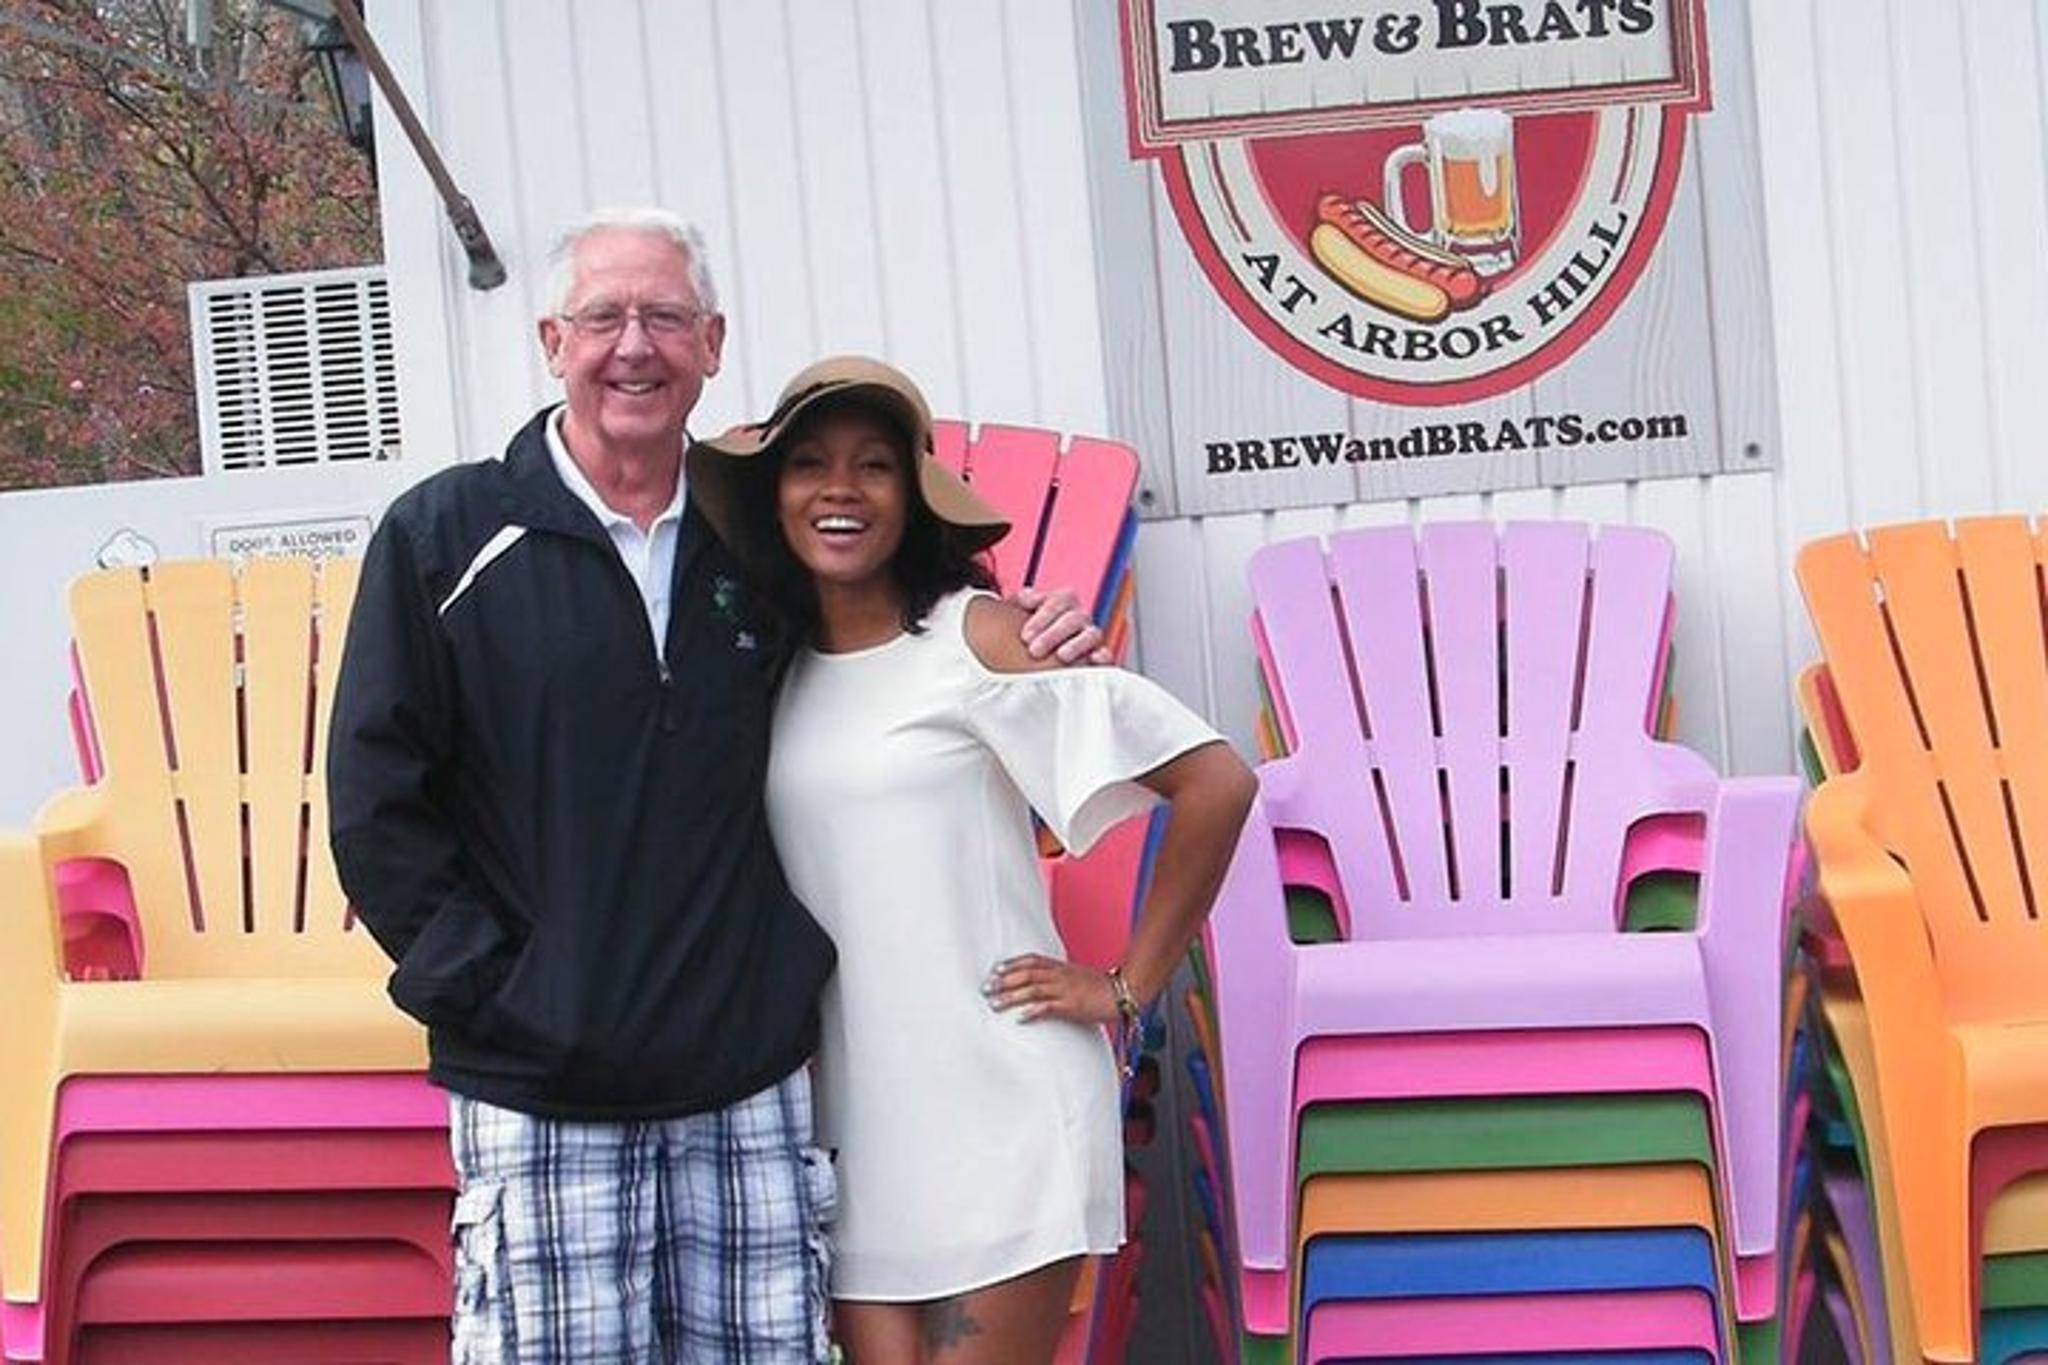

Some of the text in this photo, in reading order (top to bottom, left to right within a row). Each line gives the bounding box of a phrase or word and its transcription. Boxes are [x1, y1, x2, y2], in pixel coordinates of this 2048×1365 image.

[1168, 0, 1655, 73] BREW & BRATS
[1242, 210, 1628, 362] AT ARBOR HILL
[1205, 413, 1689, 475] BREWandBRATS.com
[280, 529, 357, 547] ALLOWED
